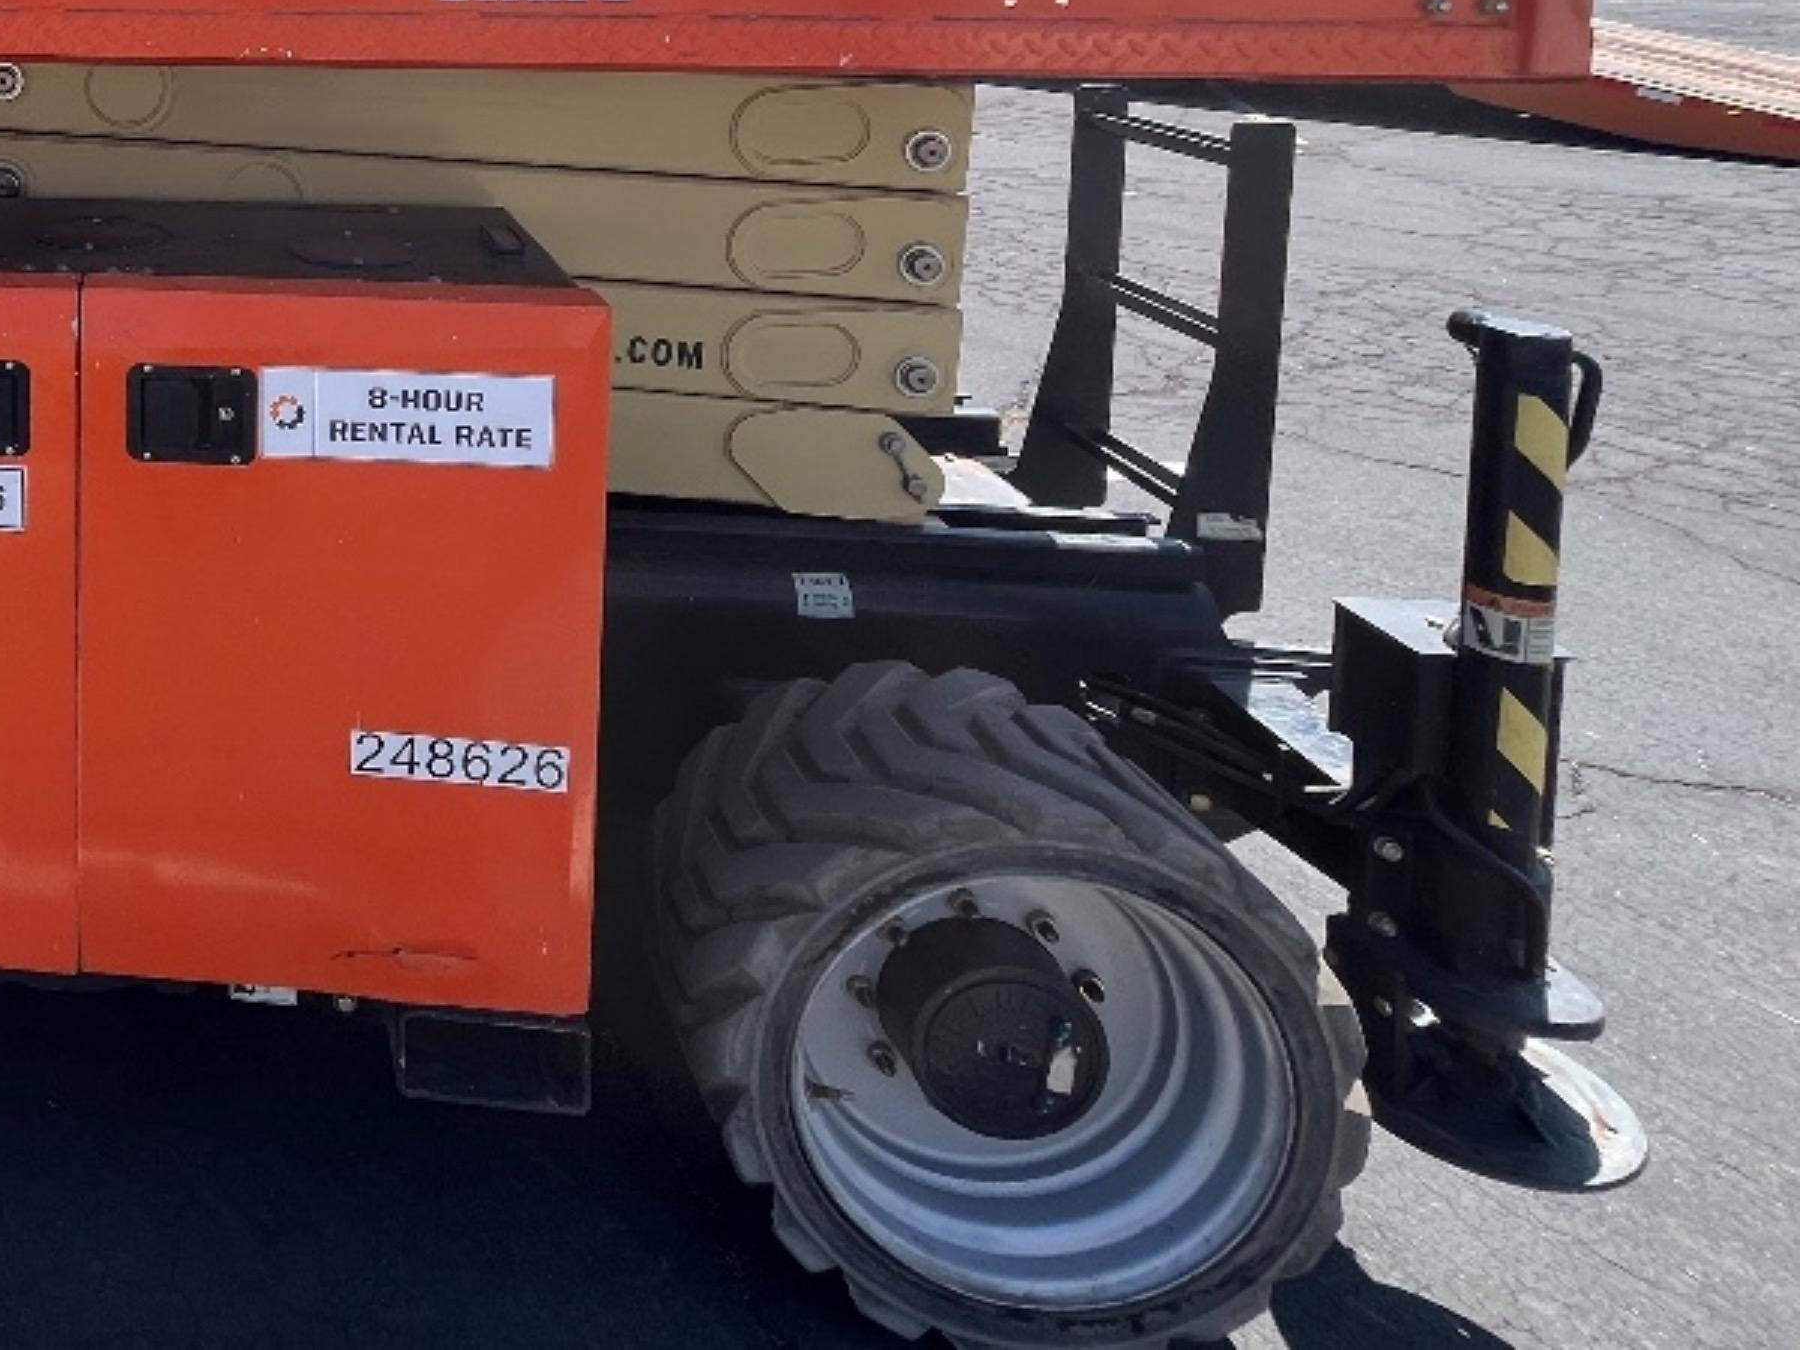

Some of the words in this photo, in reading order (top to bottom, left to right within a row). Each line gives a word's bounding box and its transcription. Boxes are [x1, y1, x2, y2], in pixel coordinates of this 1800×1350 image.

[614, 335, 704, 370] .COM
[367, 387, 485, 412] 8-HOUR
[328, 419, 442, 446] RENTAL
[455, 423, 533, 450] RATE
[354, 733, 564, 789] 248626
